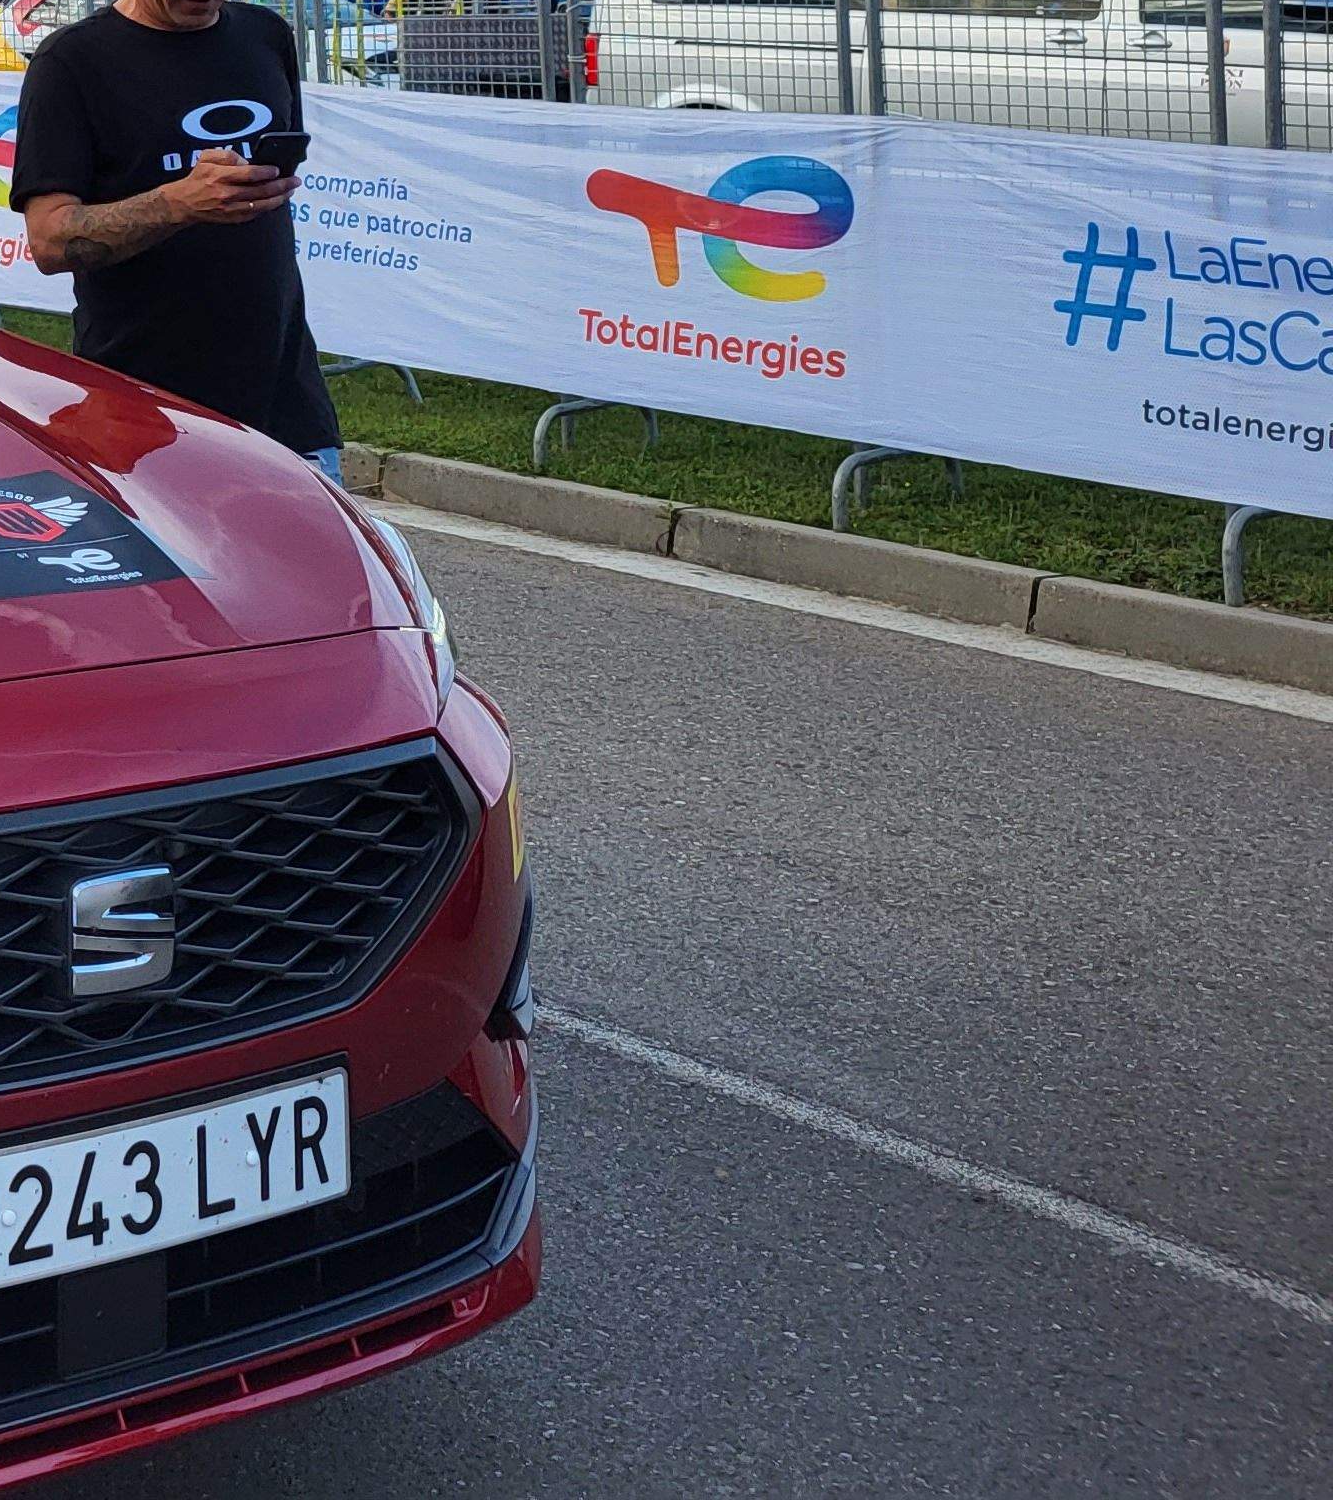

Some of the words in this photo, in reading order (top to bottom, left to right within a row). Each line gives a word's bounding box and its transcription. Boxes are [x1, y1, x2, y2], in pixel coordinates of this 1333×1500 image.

[303, 173, 408, 201] compañía
[319, 208, 360, 229] que
[366, 214, 473, 244] patrocina
[307, 240, 419, 271] preferidas
[578, 307, 846, 380] TotalEnergies
[65, 570, 143, 584] TotalEnergies
[196, 1096, 330, 1220] LYR
